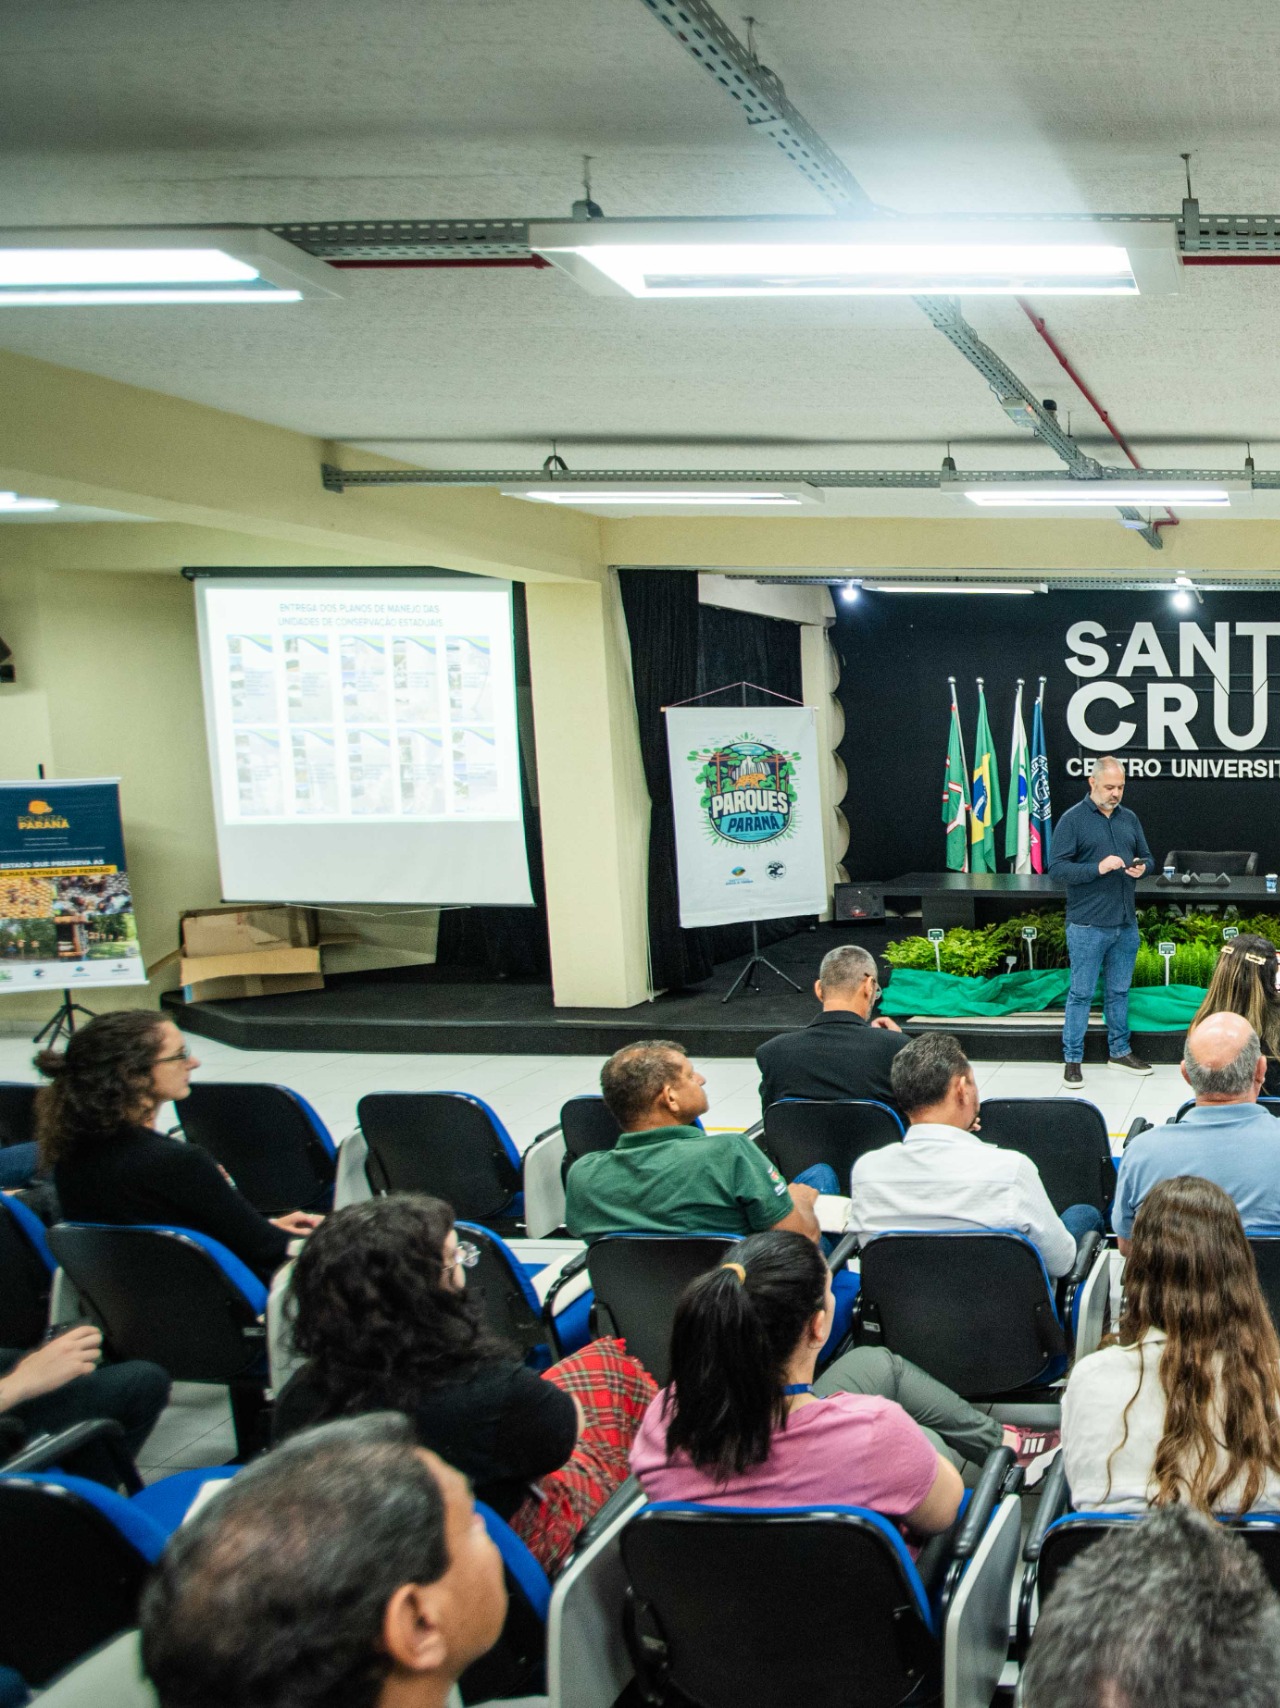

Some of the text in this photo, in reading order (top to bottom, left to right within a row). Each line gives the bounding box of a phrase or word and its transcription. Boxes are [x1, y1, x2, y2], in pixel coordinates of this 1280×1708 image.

[279, 603, 440, 614] ENTREGA DOS PLANOS DE MANEJO DAS
[277, 617, 320, 627] UNIDADES
[322, 617, 333, 627] DE
[398, 617, 444, 627] ESTADUAIS
[1066, 758, 1162, 777] CETRO
[711, 790, 790, 818] PARQUES
[18, 818, 70, 830] PARANÁ
[727, 815, 781, 832] PARANÁ
